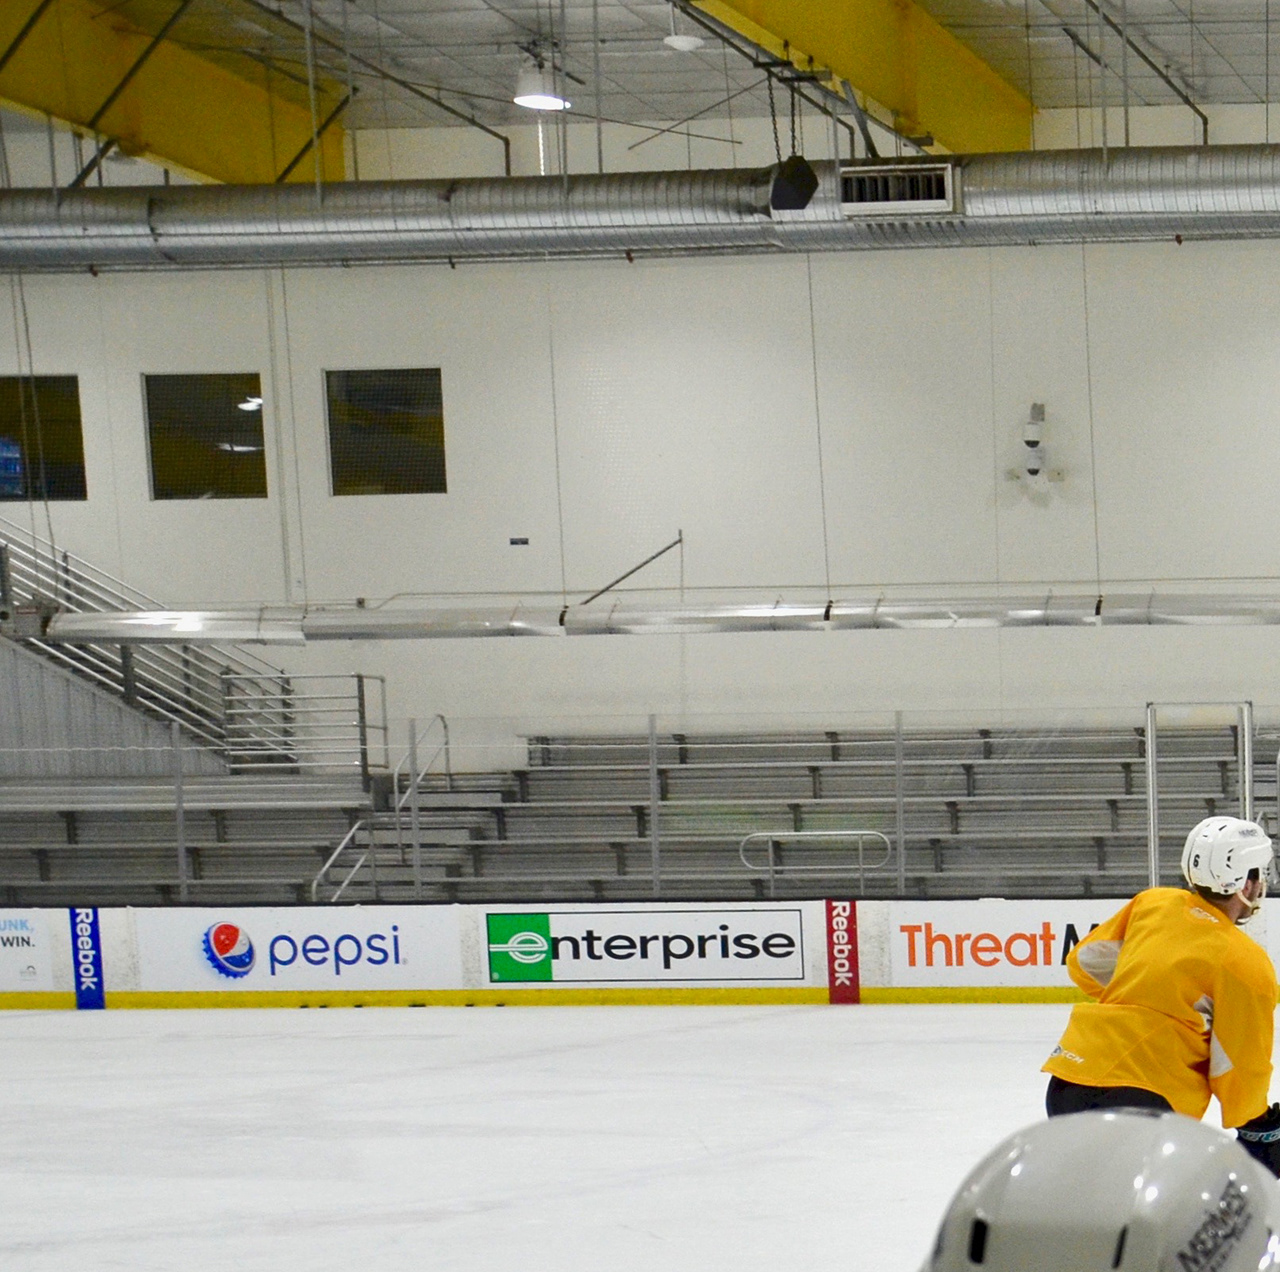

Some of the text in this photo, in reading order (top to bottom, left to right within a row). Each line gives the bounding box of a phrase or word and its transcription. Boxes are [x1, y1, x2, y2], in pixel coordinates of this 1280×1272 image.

[1, 936, 36, 947] WIN.
[75, 908, 98, 990] Reebok
[270, 925, 401, 975] pepsi
[489, 924, 796, 969] enterprise
[831, 901, 851, 986] Reebok
